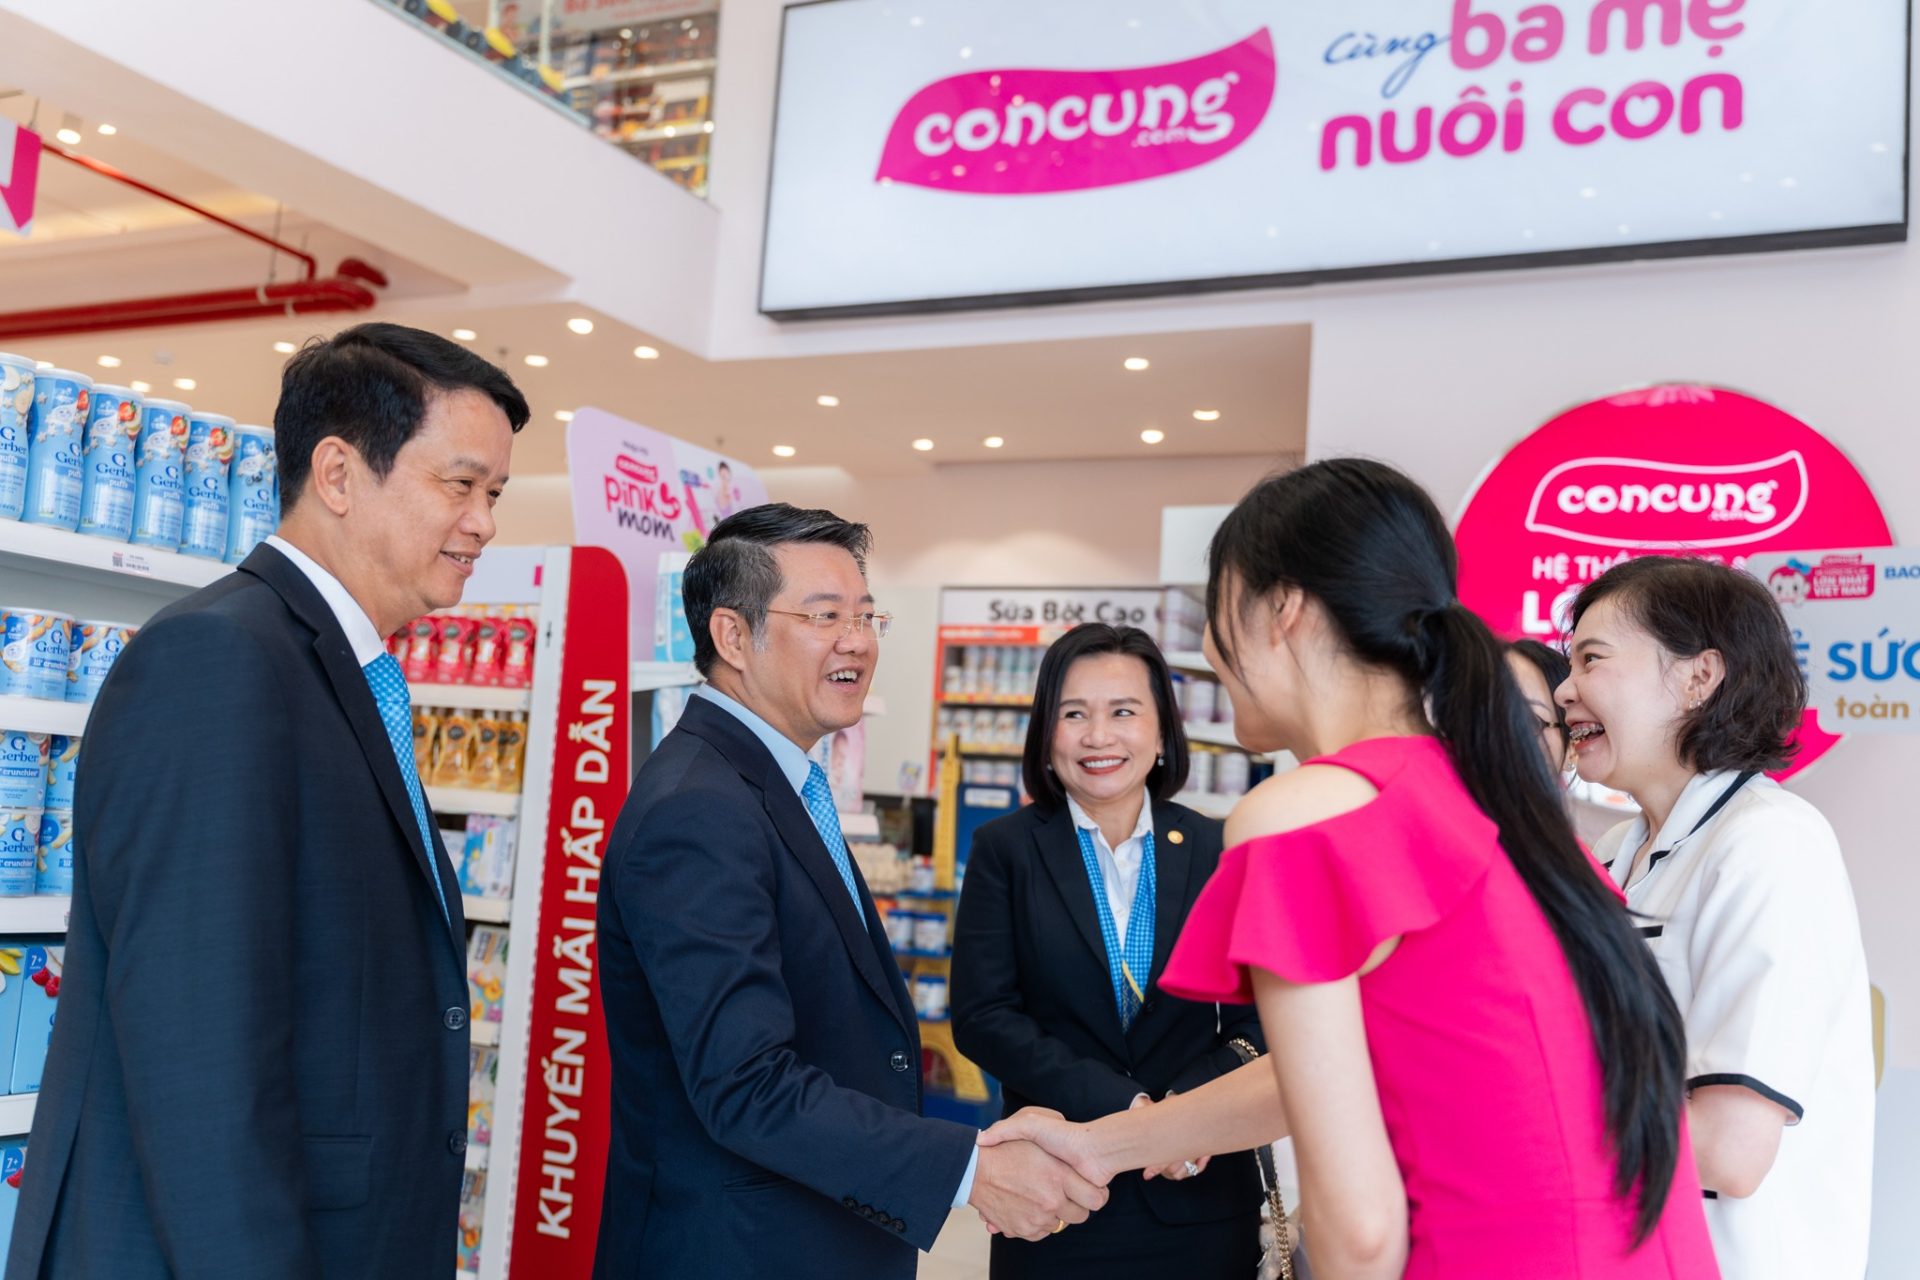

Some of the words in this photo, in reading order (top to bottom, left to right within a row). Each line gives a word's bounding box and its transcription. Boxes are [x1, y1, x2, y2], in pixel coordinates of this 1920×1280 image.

[1450, 0, 1565, 71] ba
[1587, 0, 1746, 58] mẹ
[913, 71, 1239, 156] concung
[1319, 80, 1525, 171] nuôi
[1551, 72, 1744, 146] con
[1557, 478, 1779, 524] concung
[1532, 552, 1569, 584] HỆ
[1094, 600, 1145, 622] Cao
[568, 679, 616, 784] DẪN
[1835, 693, 1910, 719] toàn
[560, 796, 605, 903] HẤP
[552, 915, 596, 1015] MÃI
[535, 1028, 588, 1240] KHUYẾN
